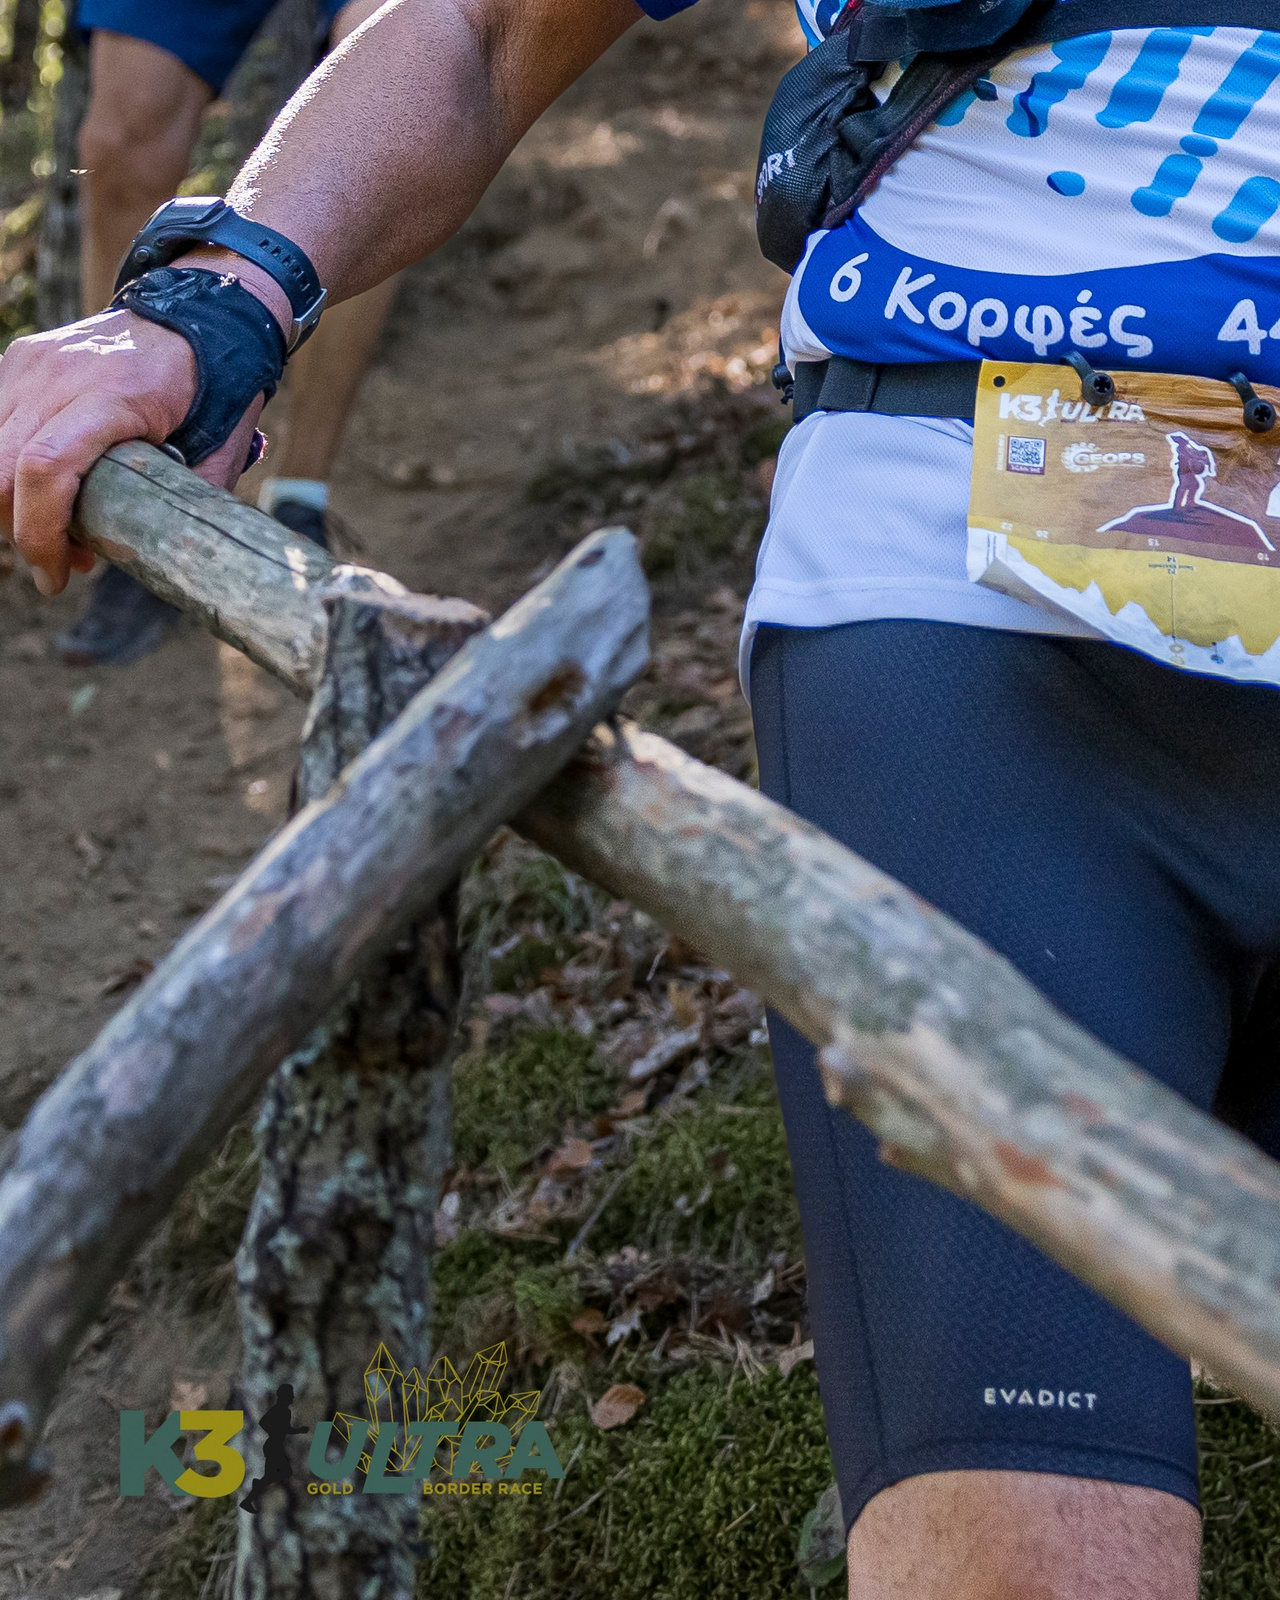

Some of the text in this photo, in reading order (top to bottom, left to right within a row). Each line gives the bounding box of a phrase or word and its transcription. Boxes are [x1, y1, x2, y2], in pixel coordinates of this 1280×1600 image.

[829, 253, 1153, 357] 6 Κορφές
[1000, 392, 1043, 422] K3
[984, 1387, 1098, 1411] EVADICT
